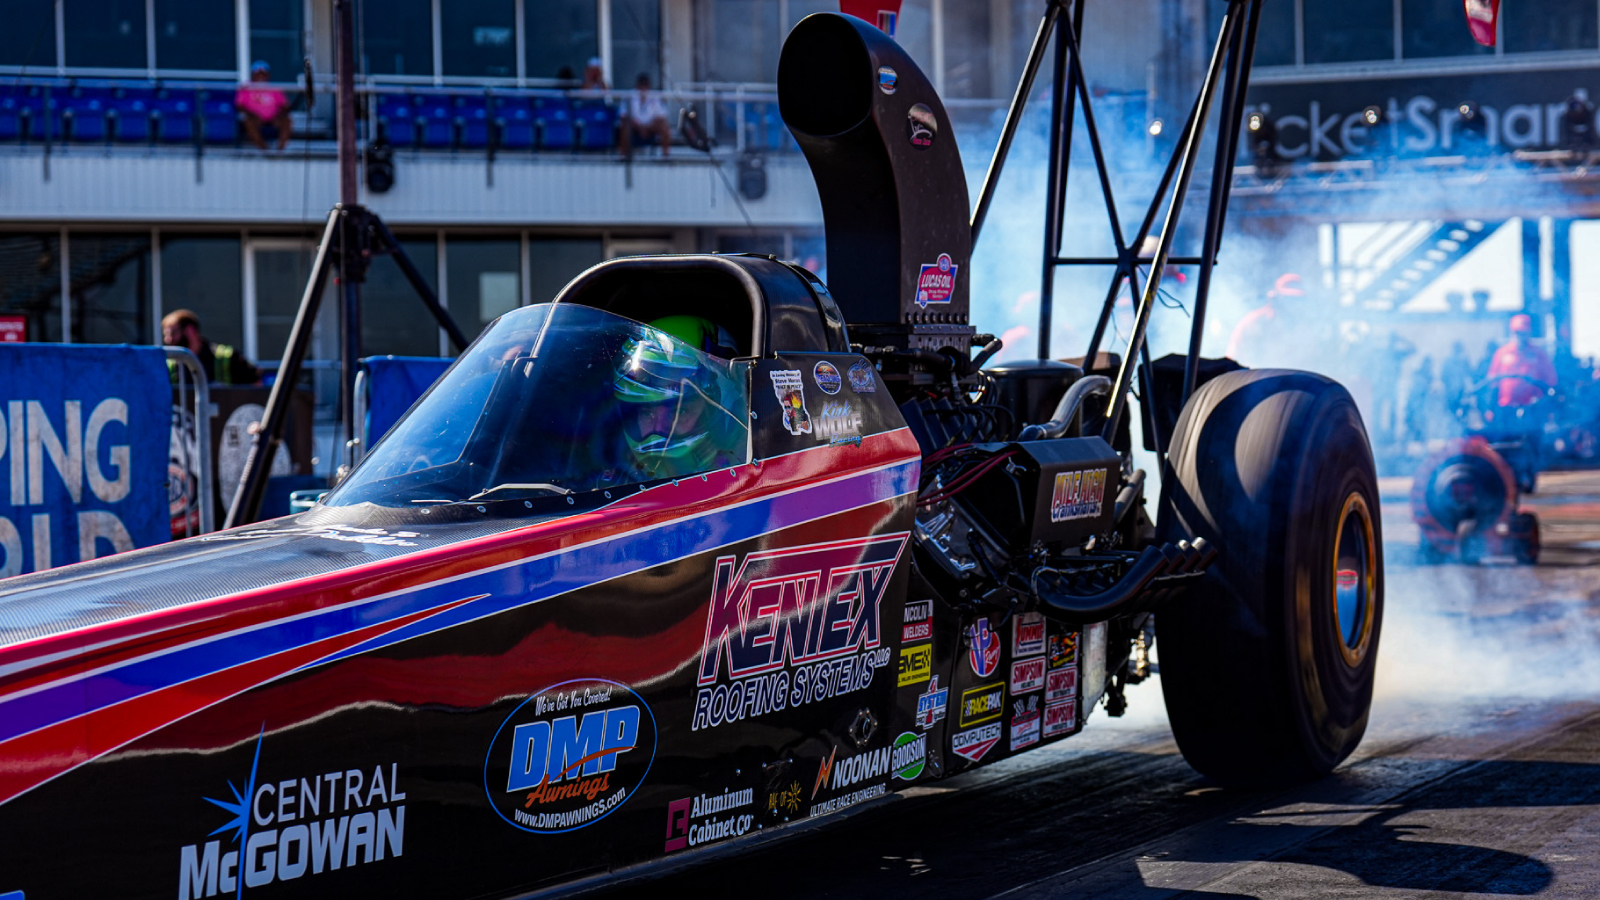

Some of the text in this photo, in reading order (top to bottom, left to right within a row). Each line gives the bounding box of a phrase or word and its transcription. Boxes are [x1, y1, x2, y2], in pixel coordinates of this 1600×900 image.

[921, 275, 951, 288] LUCAS OIL
[813, 413, 863, 440] WOLF
[0, 397, 131, 506] ING
[1053, 471, 1081, 508] MILE
[903, 623, 929, 639] WELDERS
[1015, 616, 1044, 648] SUMMIT
[1013, 661, 1044, 684] SIMPSON
[1048, 671, 1075, 692] SIMPSON
[535, 685, 613, 716] We've Got You Covered!
[692, 671, 789, 731] ROOFING
[791, 652, 876, 707] SYSTEMS
[969, 691, 1002, 716] RACEPAK
[1045, 703, 1074, 726] SIMPSON
[506, 705, 641, 793] DMP
[953, 724, 1001, 749] COMPUTECH
[832, 745, 892, 790] NOONAN
[892, 738, 925, 772] GOODSON
[253, 762, 406, 826] CENTRAL
[525, 773, 610, 808] Awnings
[690, 787, 753, 818] Aluminum
[810, 782, 887, 818] ULTIMATE RACE ENGINEERING
[514, 787, 626, 829] www.DMPAWNINGS.com
[688, 815, 735, 846] Cabinet
[178, 805, 406, 900] McGOWAN
